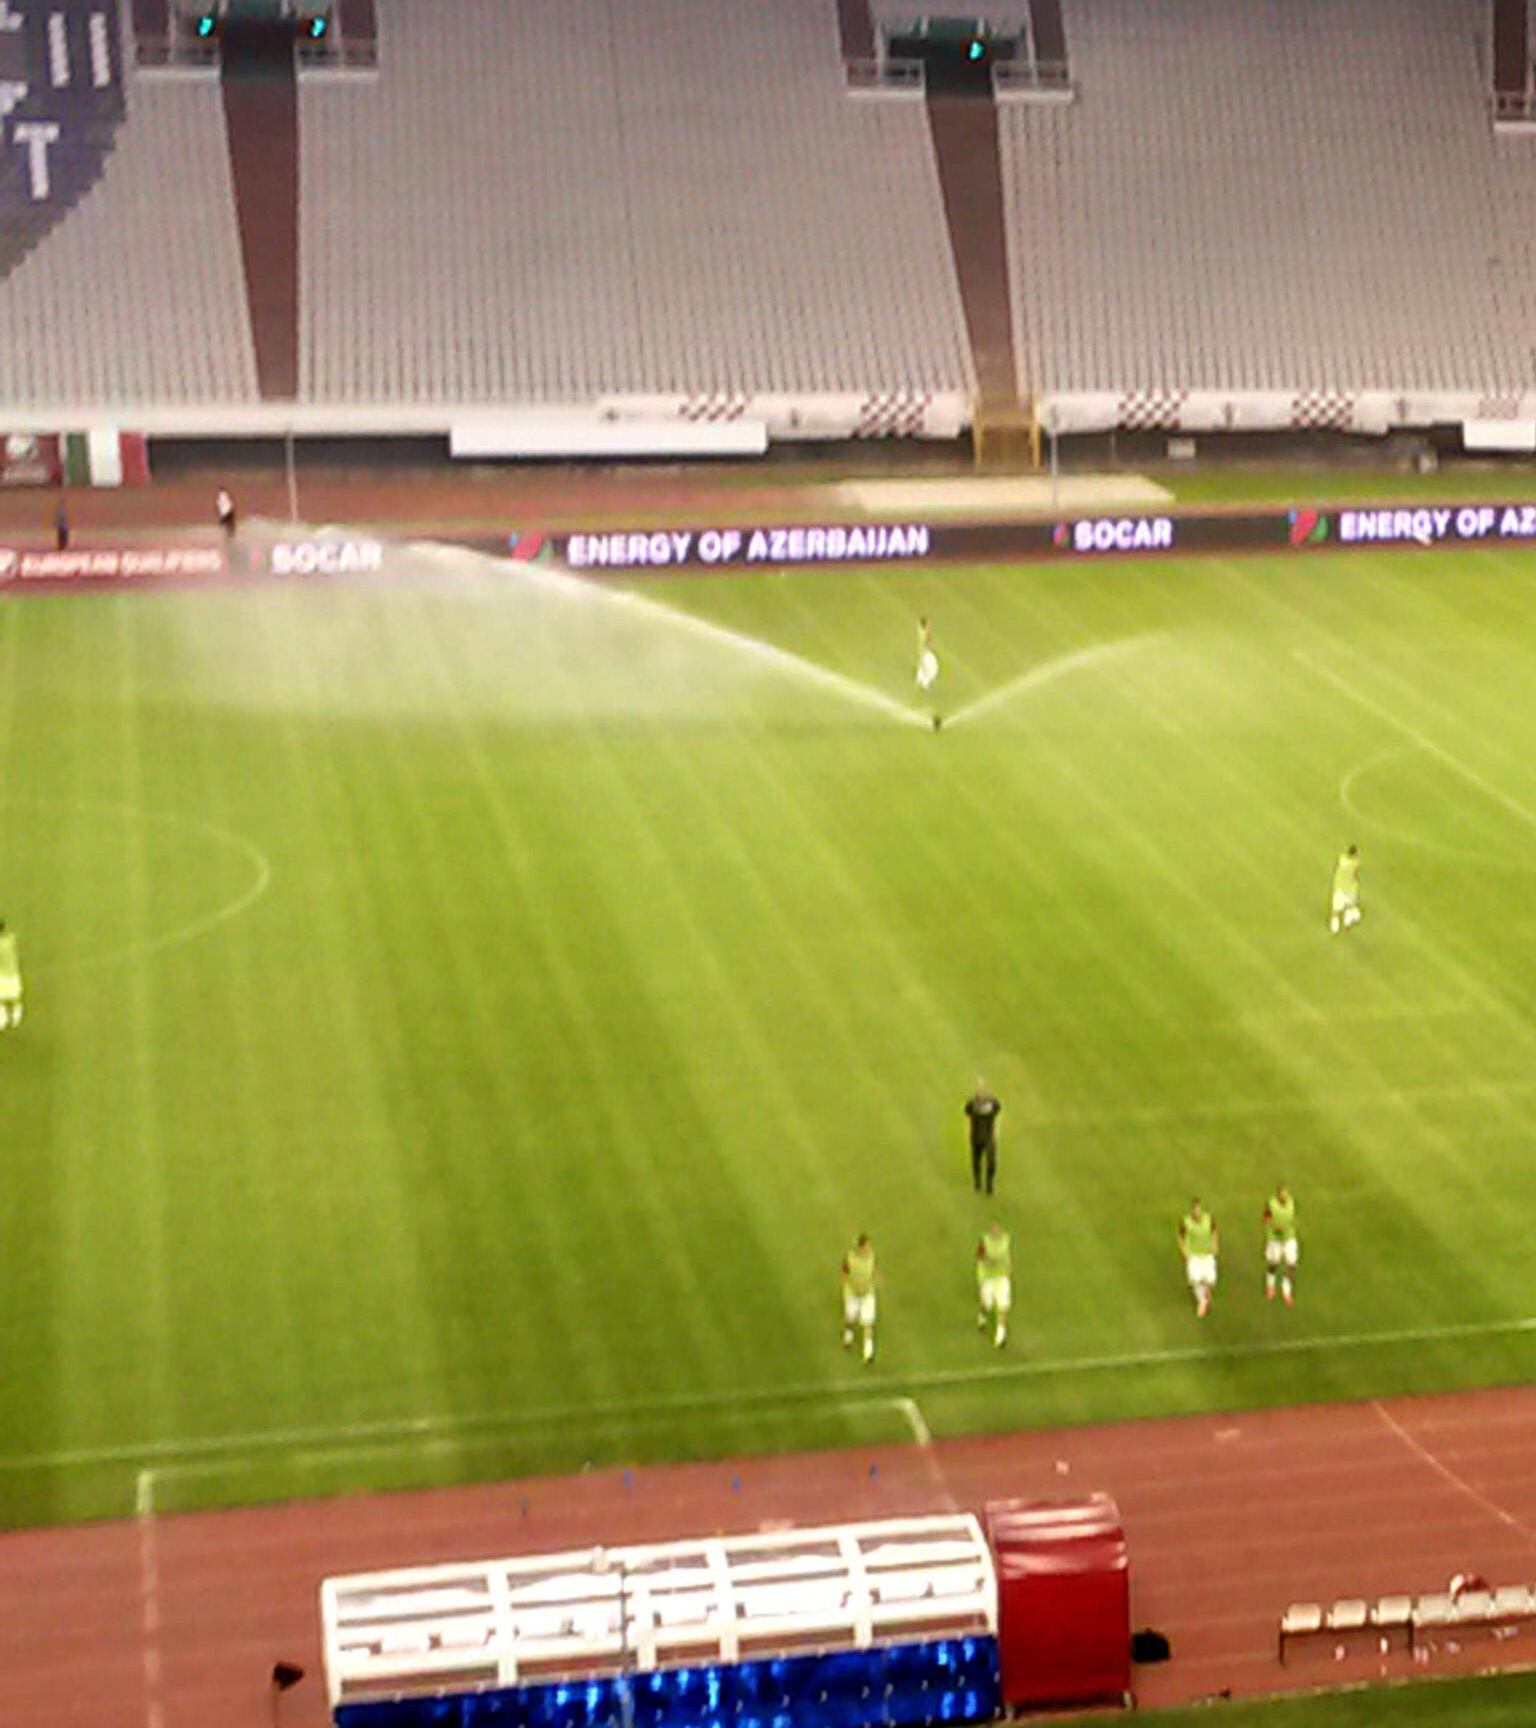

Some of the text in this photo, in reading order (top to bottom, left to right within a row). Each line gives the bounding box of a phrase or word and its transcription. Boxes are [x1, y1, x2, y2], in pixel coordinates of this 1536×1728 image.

[1073, 518, 1173, 550] SOCAR
[1340, 508, 1450, 541] ENERGY
[1456, 507, 1495, 537] OF
[271, 542, 382, 575] SOCAR
[567, 525, 930, 567] ENERGY OF AZERBAIJAN
